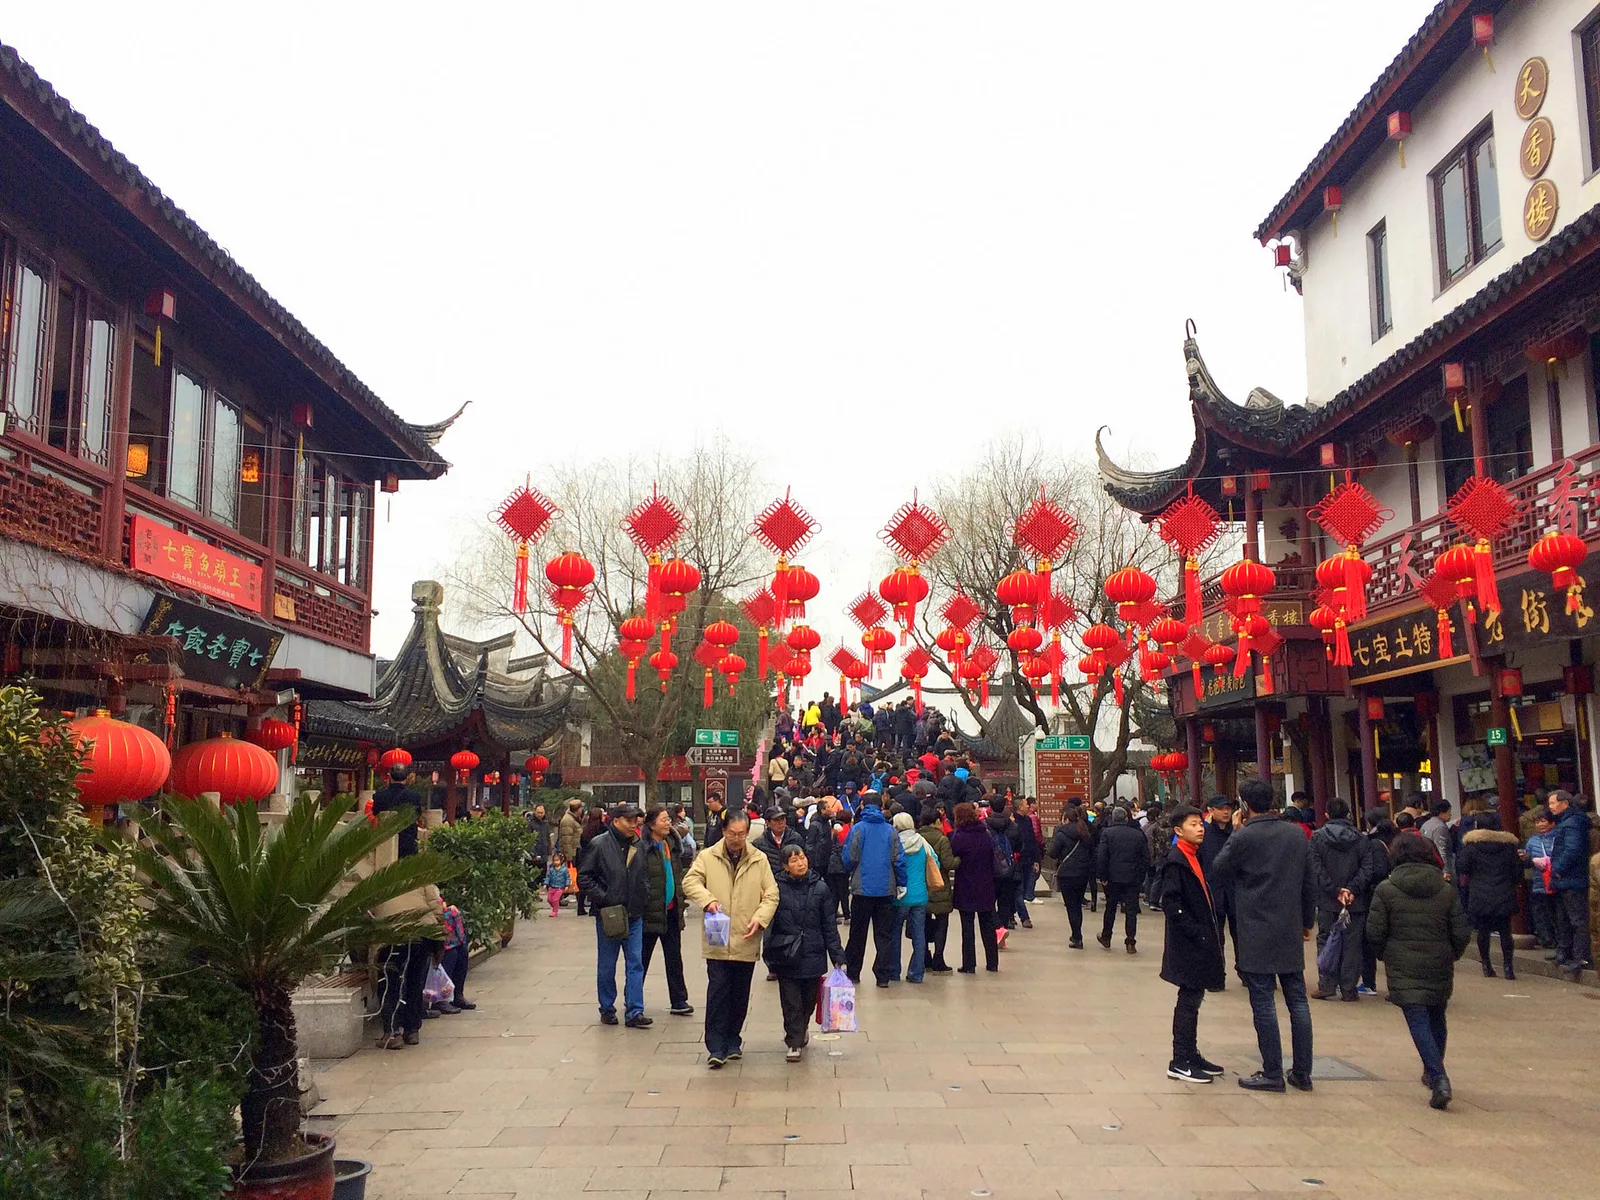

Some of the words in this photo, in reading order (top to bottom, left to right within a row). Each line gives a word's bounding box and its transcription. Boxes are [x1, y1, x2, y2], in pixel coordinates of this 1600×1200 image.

[1520, 66, 1553, 232] 天香楼
[162, 539, 242, 589] 七寶魚頭王
[1491, 729, 1501, 739] 15
